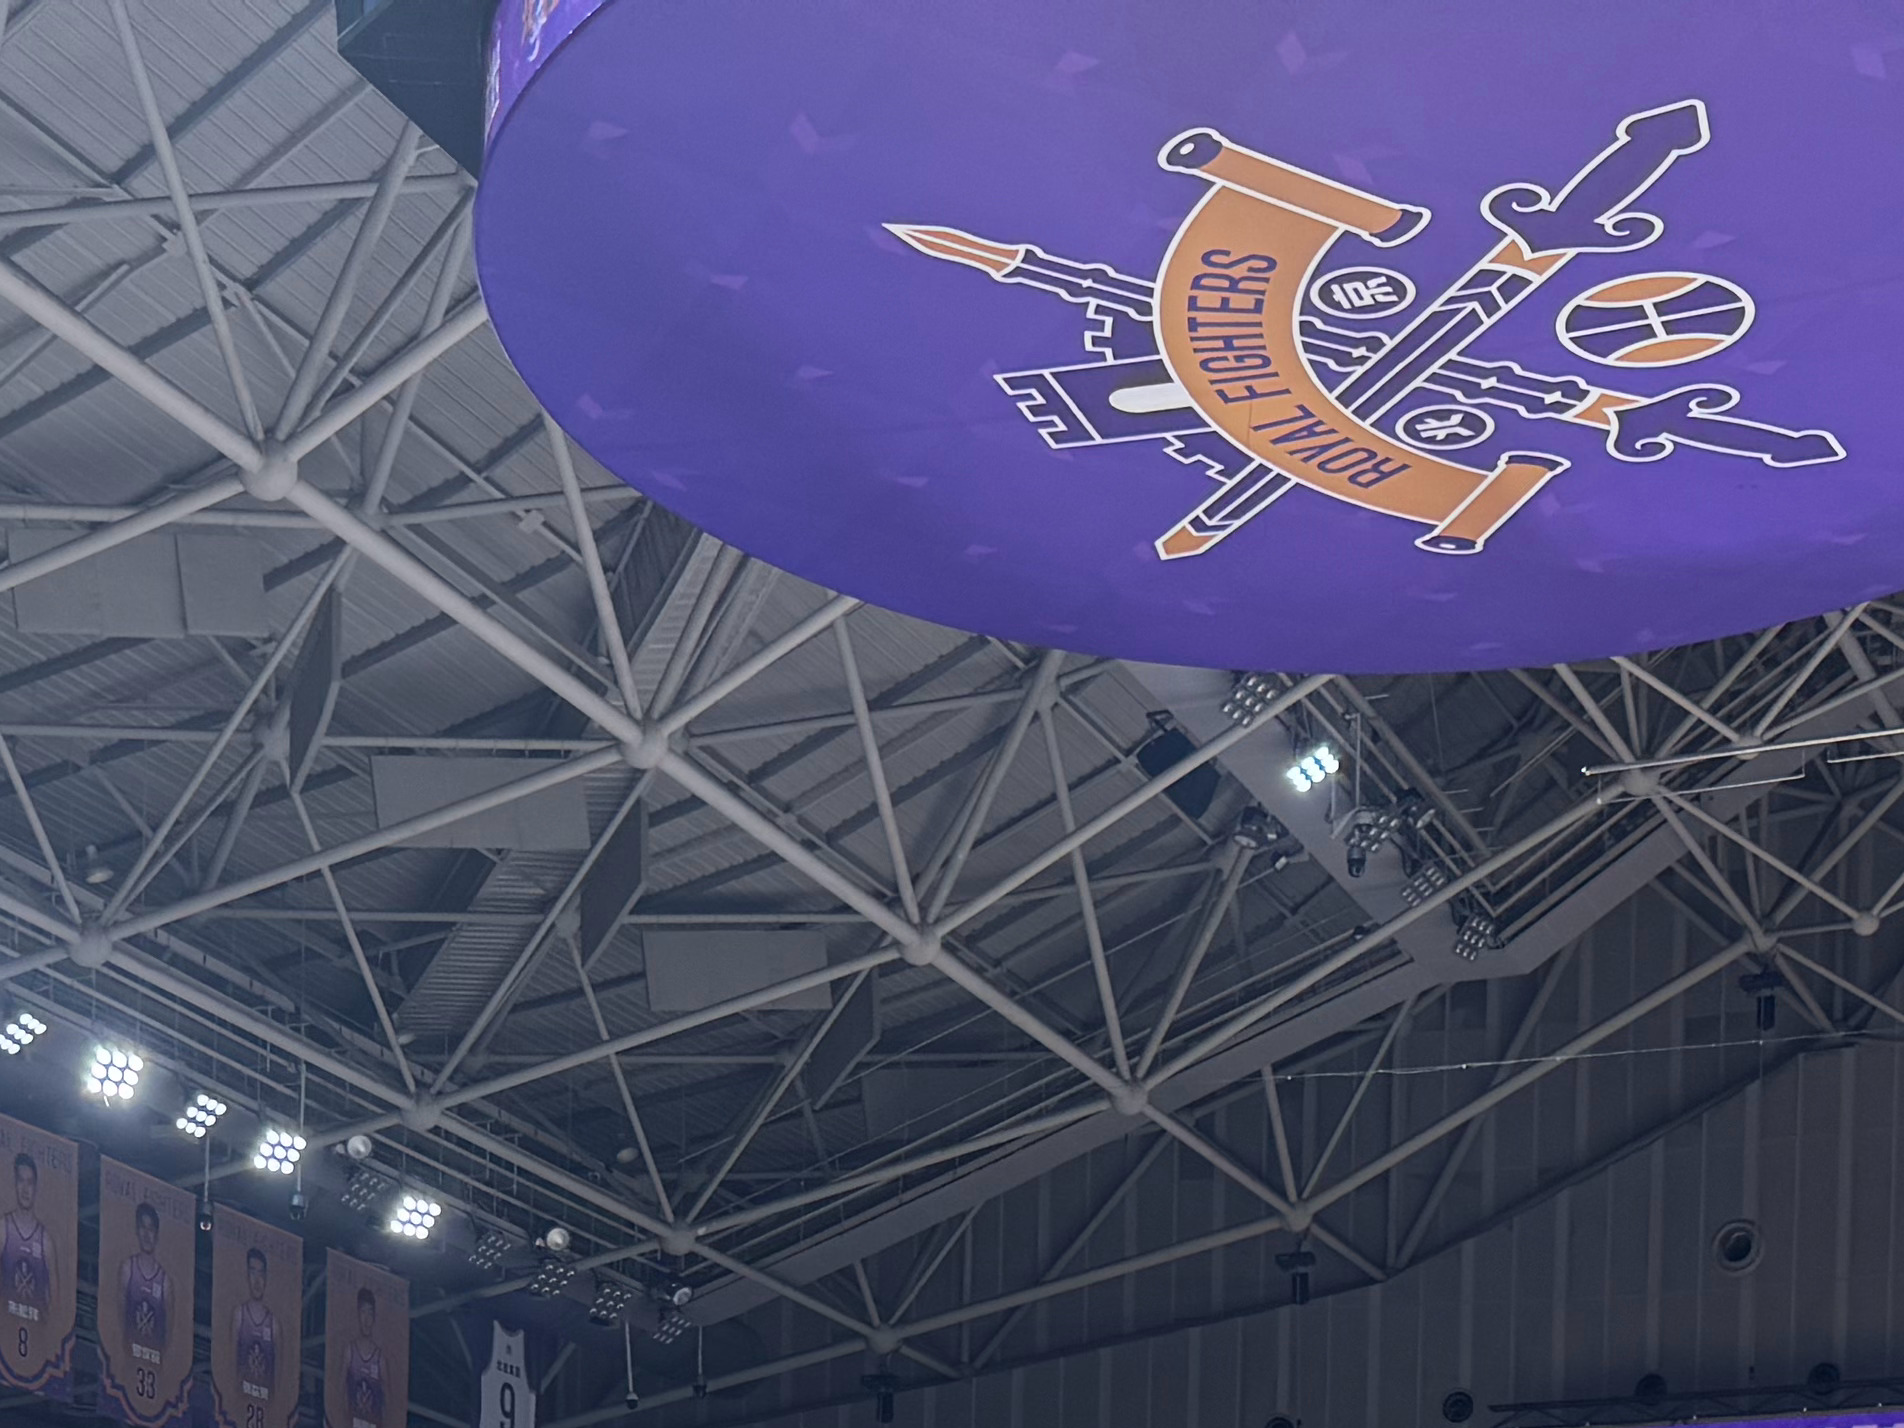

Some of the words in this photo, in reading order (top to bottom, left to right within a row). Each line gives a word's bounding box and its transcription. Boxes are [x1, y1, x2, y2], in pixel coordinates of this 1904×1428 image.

[1187, 248, 1292, 404] FIGHTERS
[1249, 404, 1412, 489] ROYAL
[19, 1327, 28, 1357] 8
[136, 1368, 156, 1399] 33
